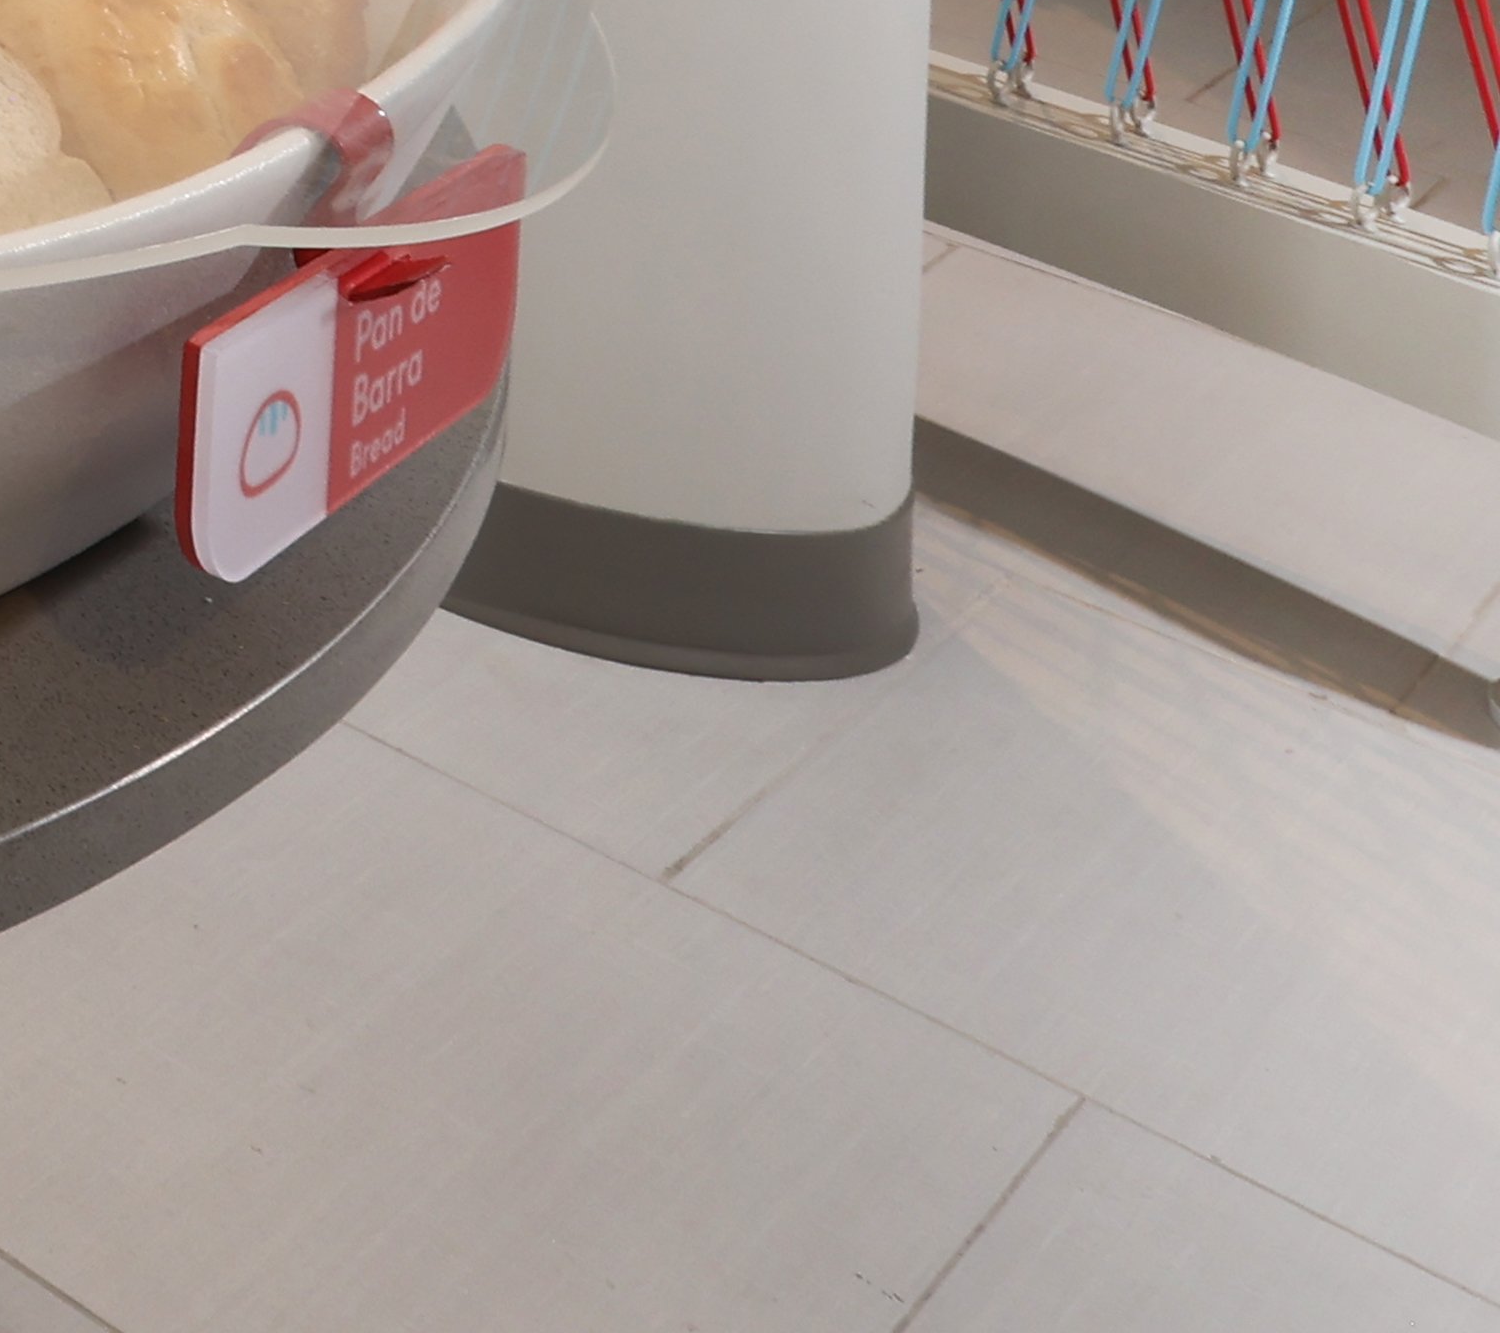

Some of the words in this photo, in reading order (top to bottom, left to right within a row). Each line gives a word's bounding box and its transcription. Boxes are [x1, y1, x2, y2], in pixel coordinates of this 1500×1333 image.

[355, 304, 403, 363] Pan
[410, 277, 442, 324] de
[351, 349, 423, 427] Barra
[349, 407, 406, 479] Bread
